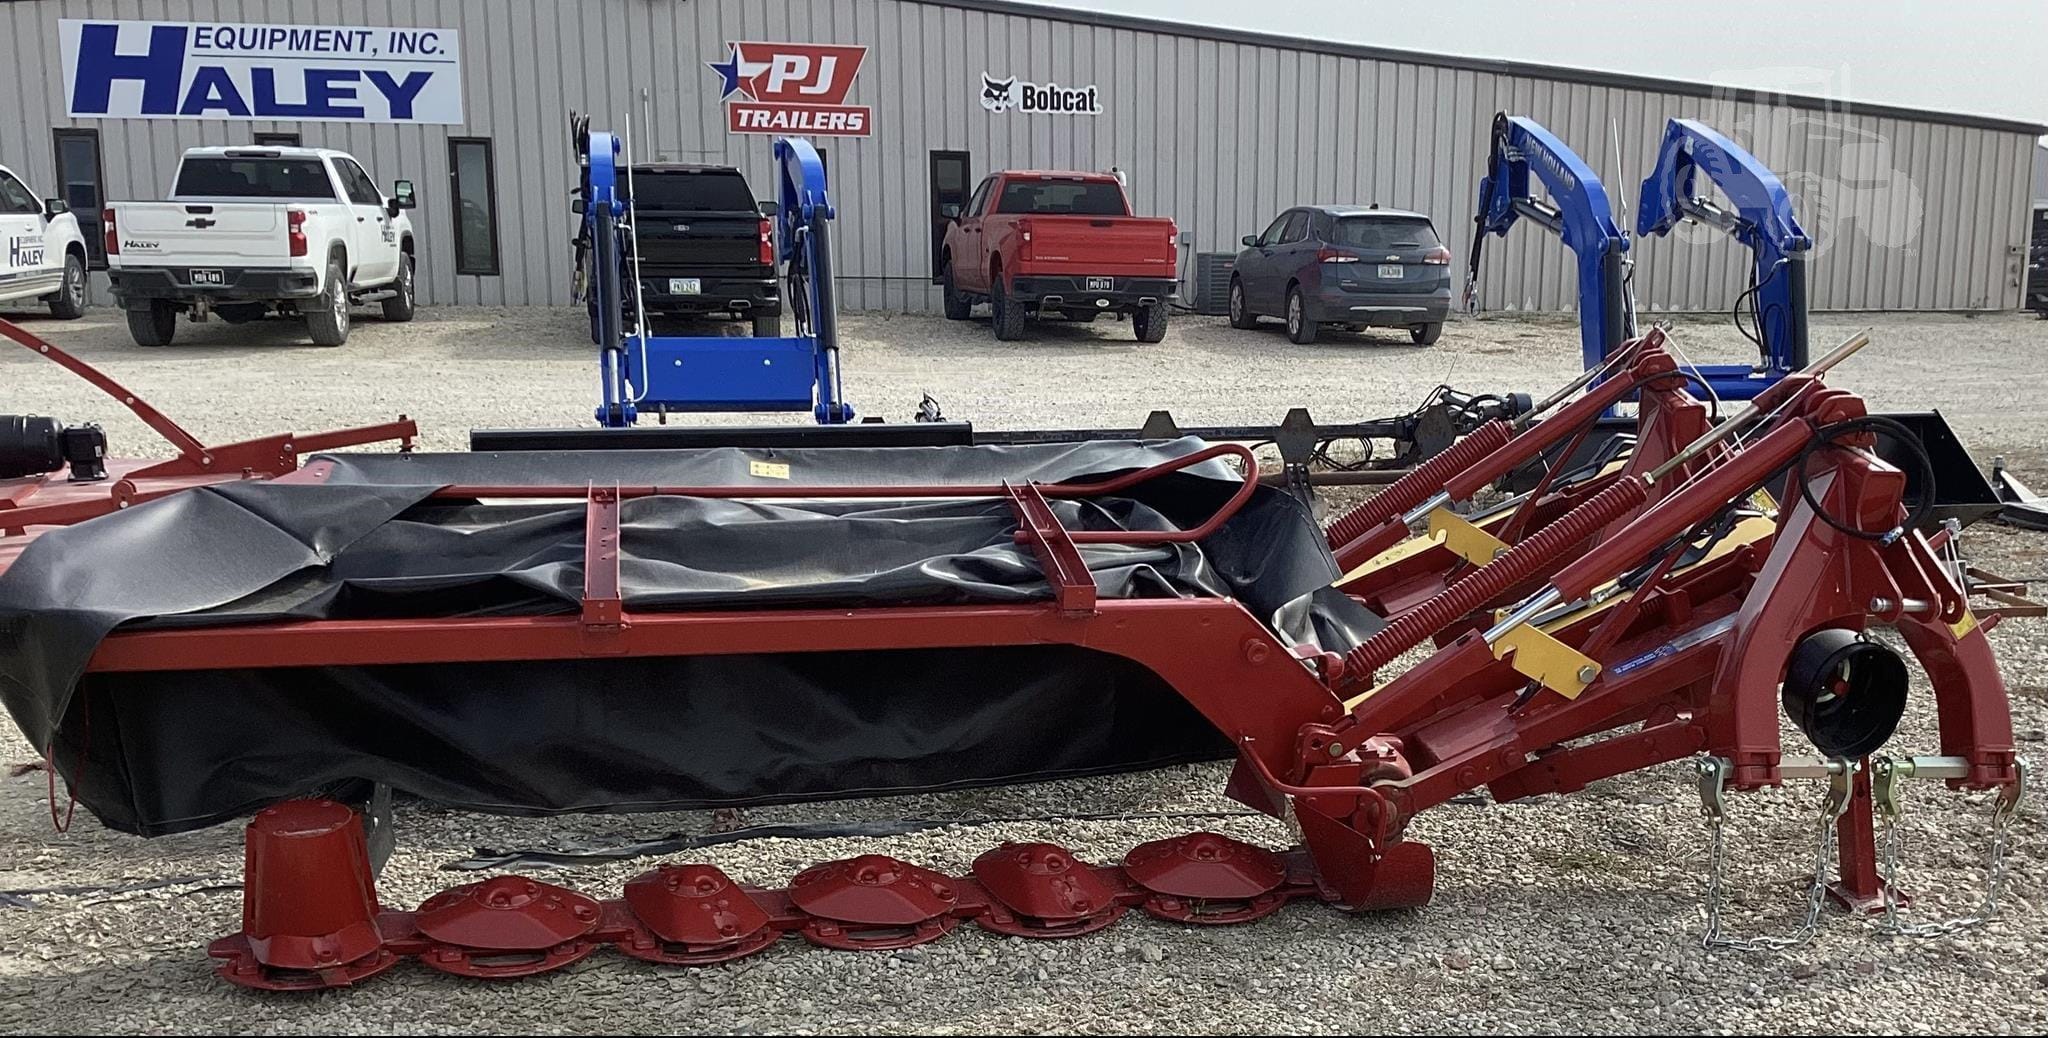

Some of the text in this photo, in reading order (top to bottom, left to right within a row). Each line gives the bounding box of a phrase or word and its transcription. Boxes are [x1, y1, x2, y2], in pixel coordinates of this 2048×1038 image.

[194, 26, 446, 57] EQUIPMENT, INC.
[70, 23, 434, 120] HALEY
[765, 54, 838, 94] PJ
[1022, 85, 1096, 112] Bobcat
[736, 109, 864, 131] TRAILERS
[1526, 133, 1576, 192] NEW HOLLAND
[10, 236, 44, 267] HALEY
[124, 240, 160, 248] HALEY
